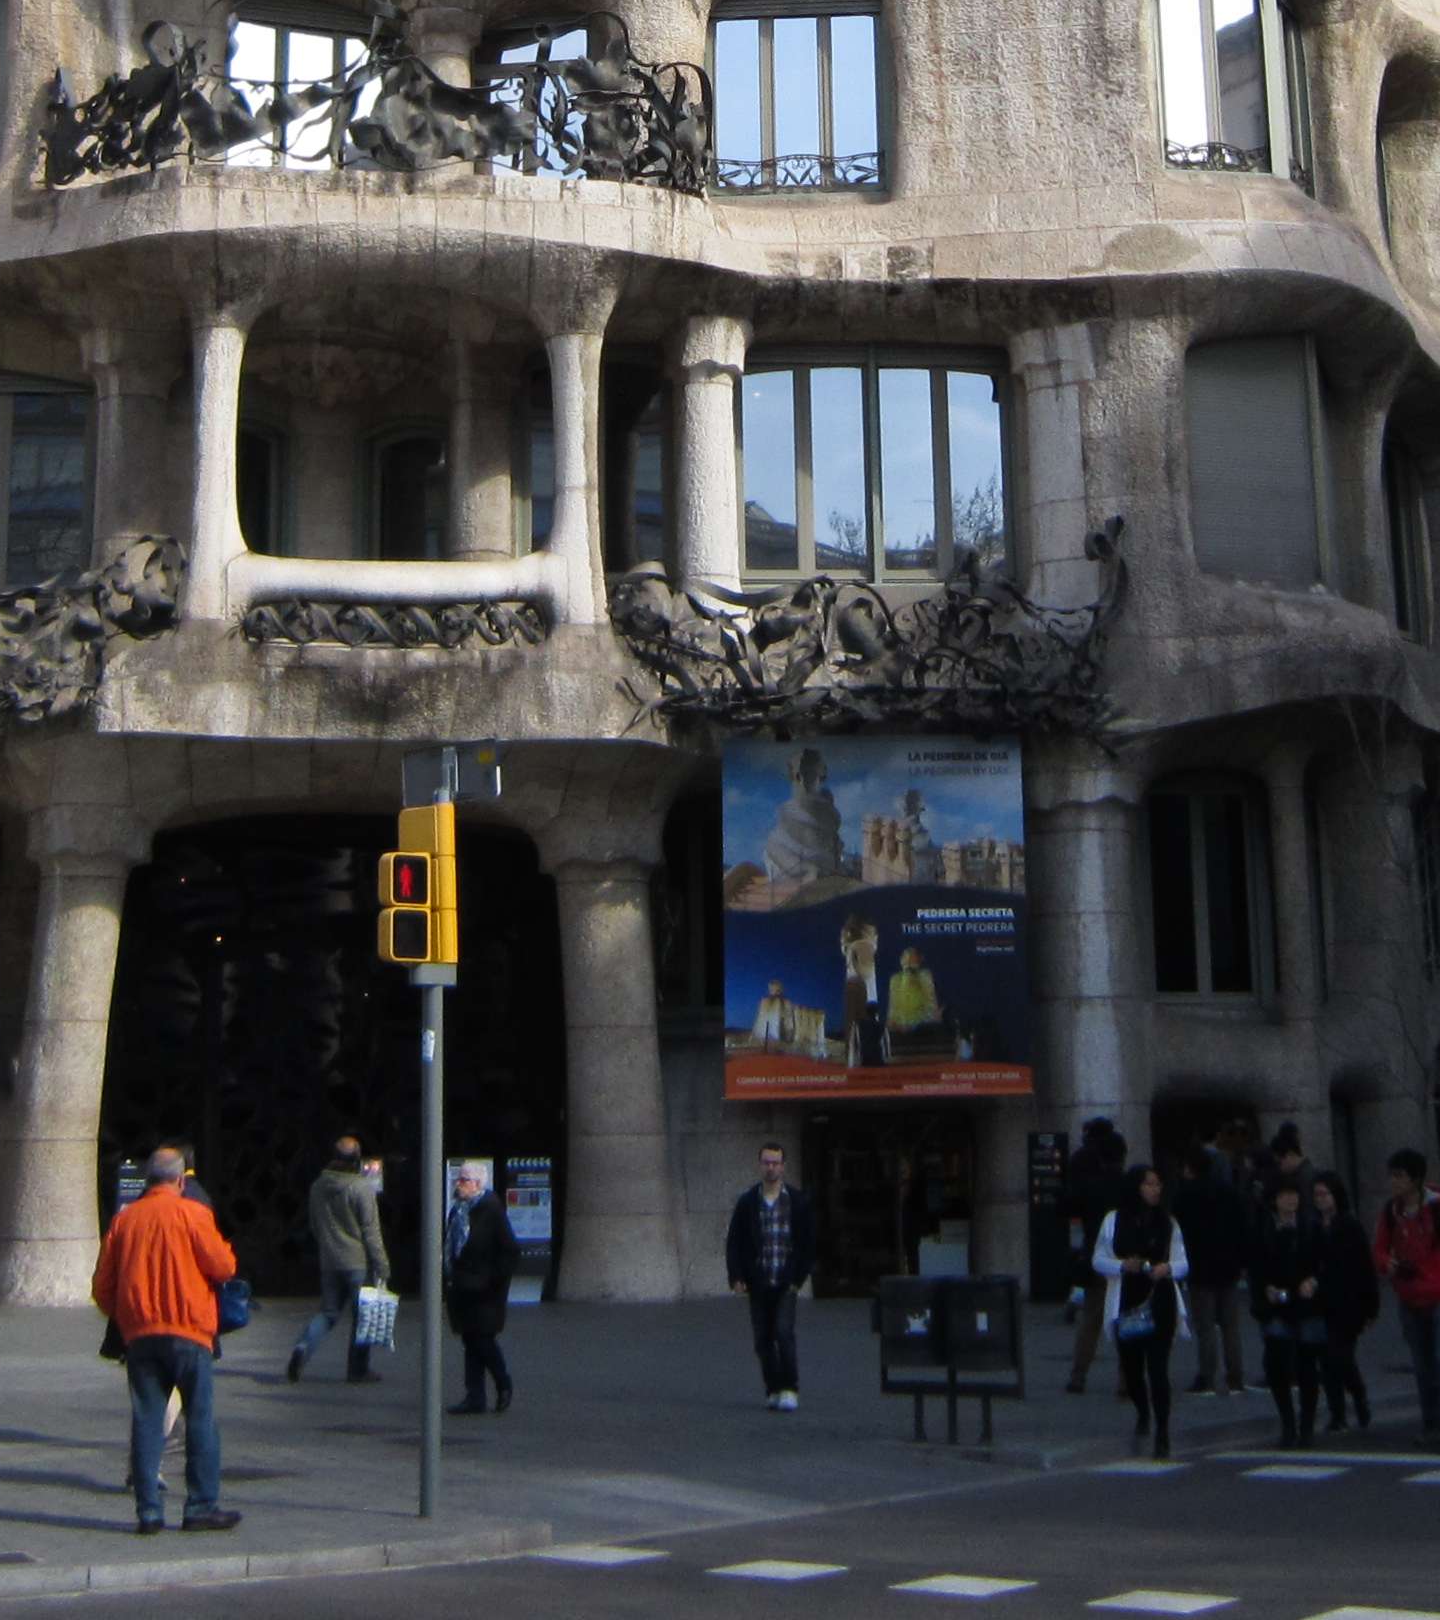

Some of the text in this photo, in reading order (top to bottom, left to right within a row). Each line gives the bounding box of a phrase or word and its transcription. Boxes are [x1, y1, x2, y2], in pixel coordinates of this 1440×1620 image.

[917, 908, 1015, 919] PEDRERA SECRETA
[901, 922, 1015, 934] THE SECRET PEDRERA
